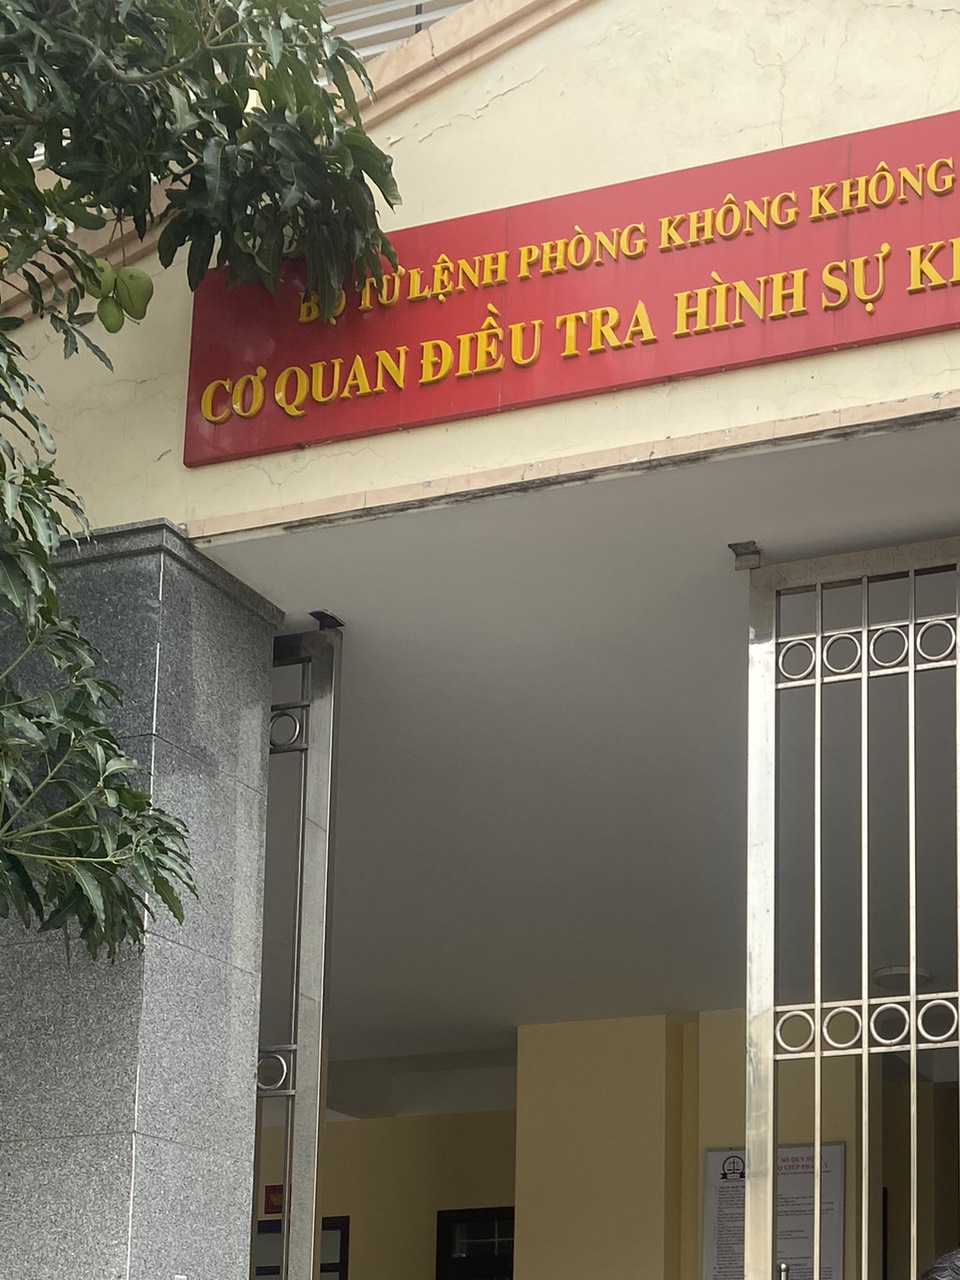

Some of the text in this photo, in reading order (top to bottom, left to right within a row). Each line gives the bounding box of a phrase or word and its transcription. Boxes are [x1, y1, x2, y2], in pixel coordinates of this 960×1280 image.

[406, 250, 508, 303] LỆNH
[518, 222, 646, 280] PHÒNG
[659, 192, 798, 253] KHÔNG
[809, 159, 956, 222] KHÔNG
[201, 364, 266, 425] CƠ
[275, 345, 408, 418] QUAN
[419, 303, 544, 386] ĐIỀU
[556, 299, 658, 359] TRA
[674, 268, 808, 338] HÌNH
[821, 242, 892, 314] SỰ
